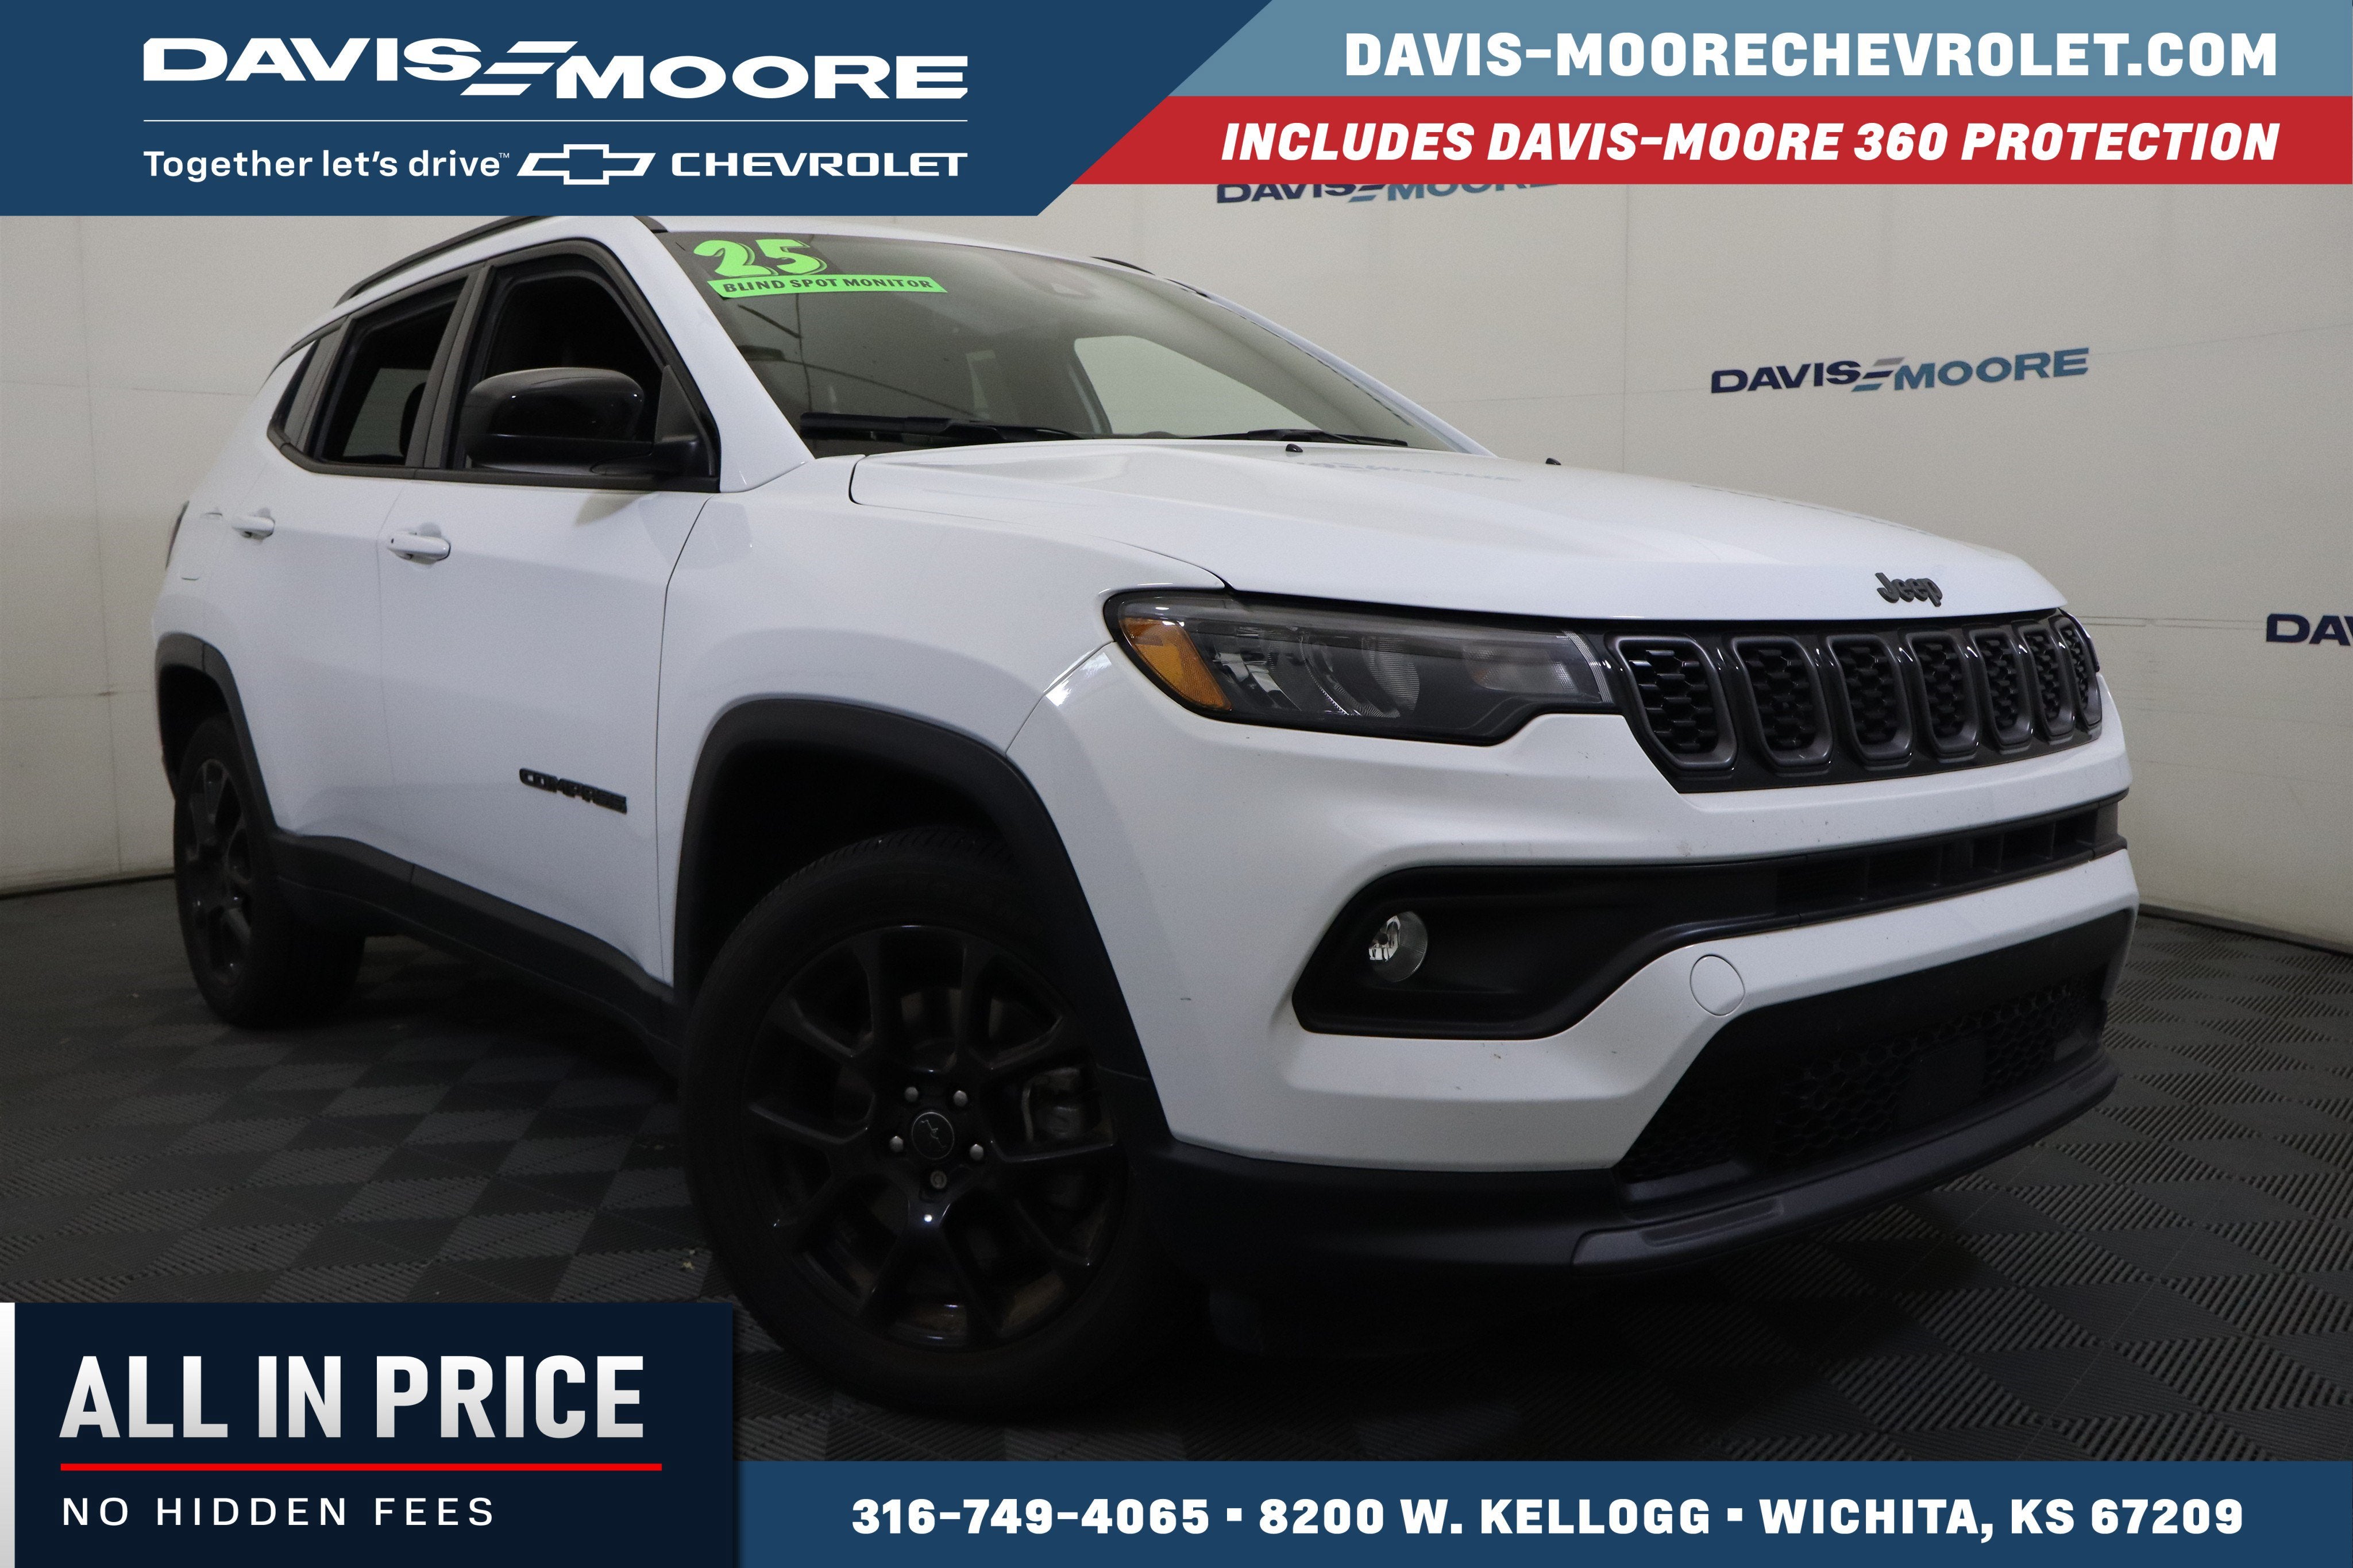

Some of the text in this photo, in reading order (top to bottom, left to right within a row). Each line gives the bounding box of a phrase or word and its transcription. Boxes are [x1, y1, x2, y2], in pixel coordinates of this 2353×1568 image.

[693, 239, 827, 277] 25
[724, 277, 933, 293] BLIND SPOT MONITOR
[1874, 572, 1943, 607] Jeep
[2266, 613, 2353, 646] DA
